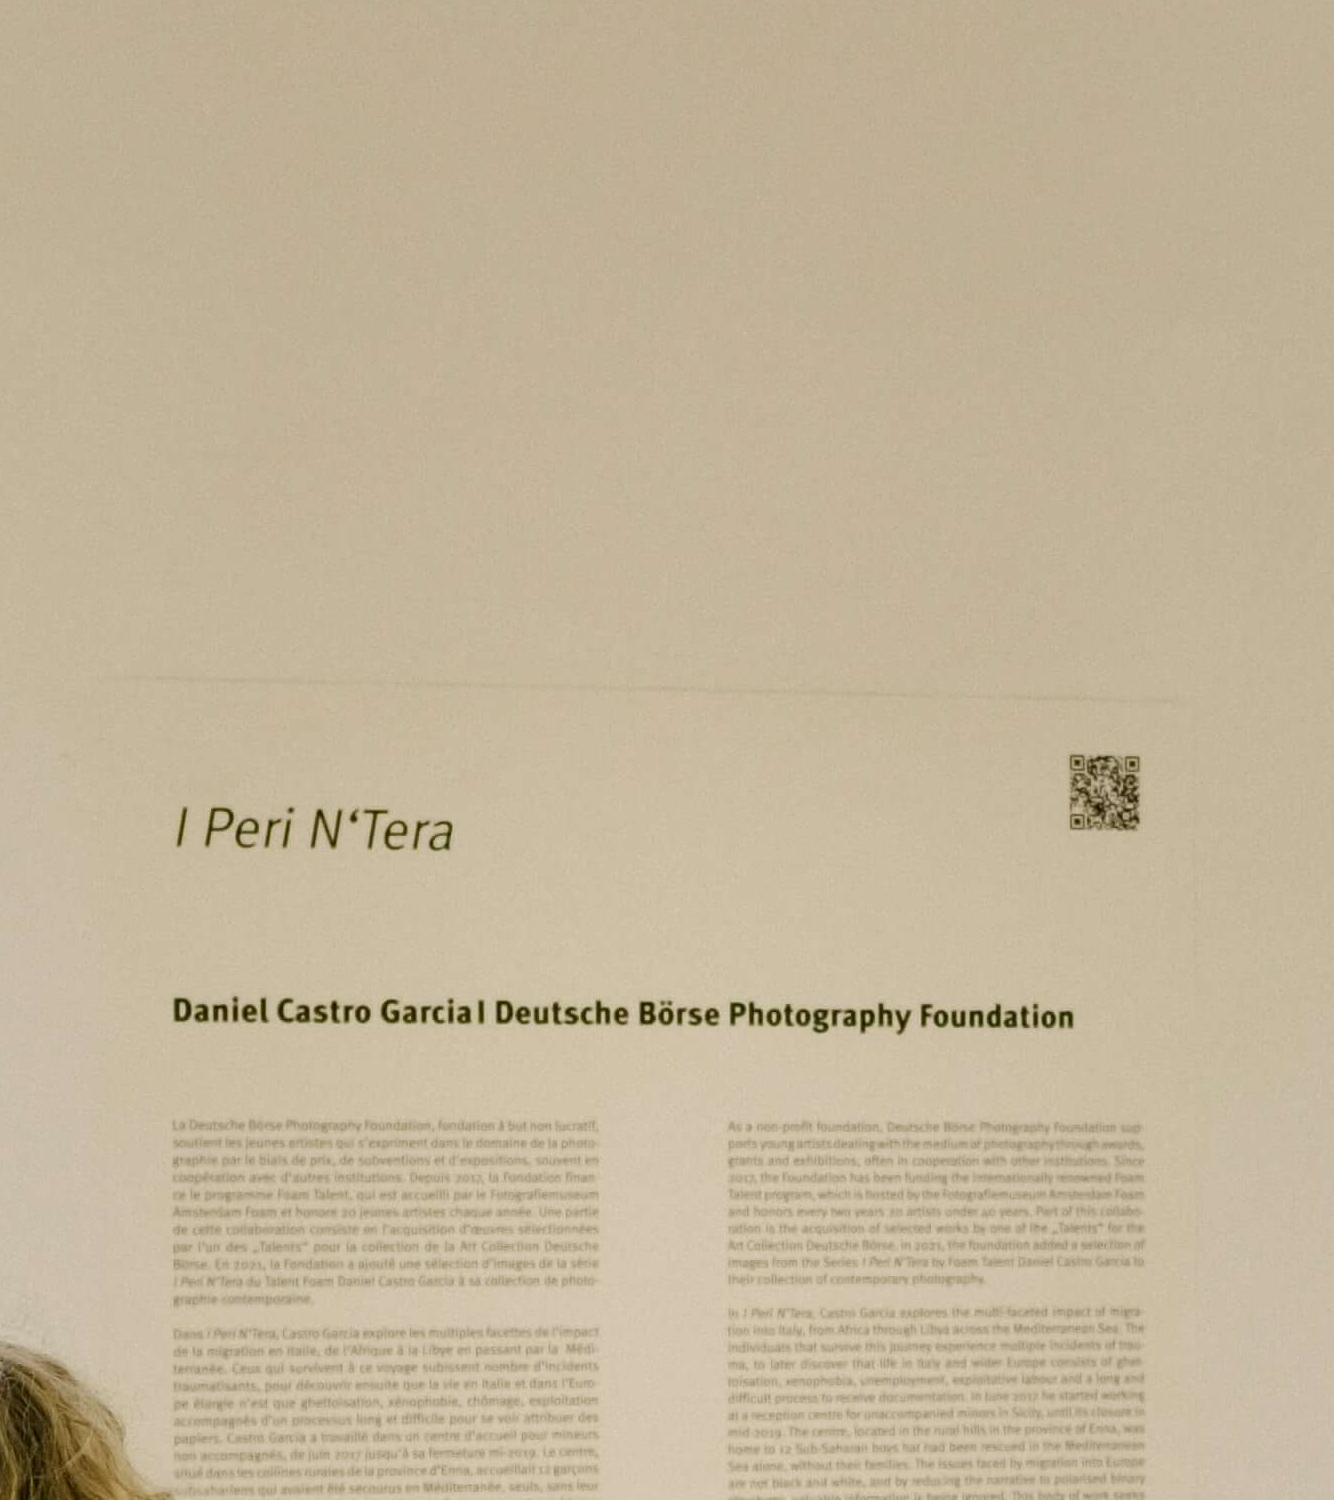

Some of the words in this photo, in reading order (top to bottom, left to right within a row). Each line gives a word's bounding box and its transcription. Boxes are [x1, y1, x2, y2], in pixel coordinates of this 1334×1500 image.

[175, 806, 188, 848] I
[204, 806, 296, 849] Peri
[172, 995, 270, 1025] Daniel
[276, 997, 372, 1025] Castro
[379, 997, 472, 1025] Garcia
[495, 999, 630, 1026] Deutsche
[638, 998, 721, 1027] Börse
[729, 1000, 913, 1036] Photography
[920, 1002, 1075, 1030] Foundation
[281, 1327, 320, 1339] Castro
